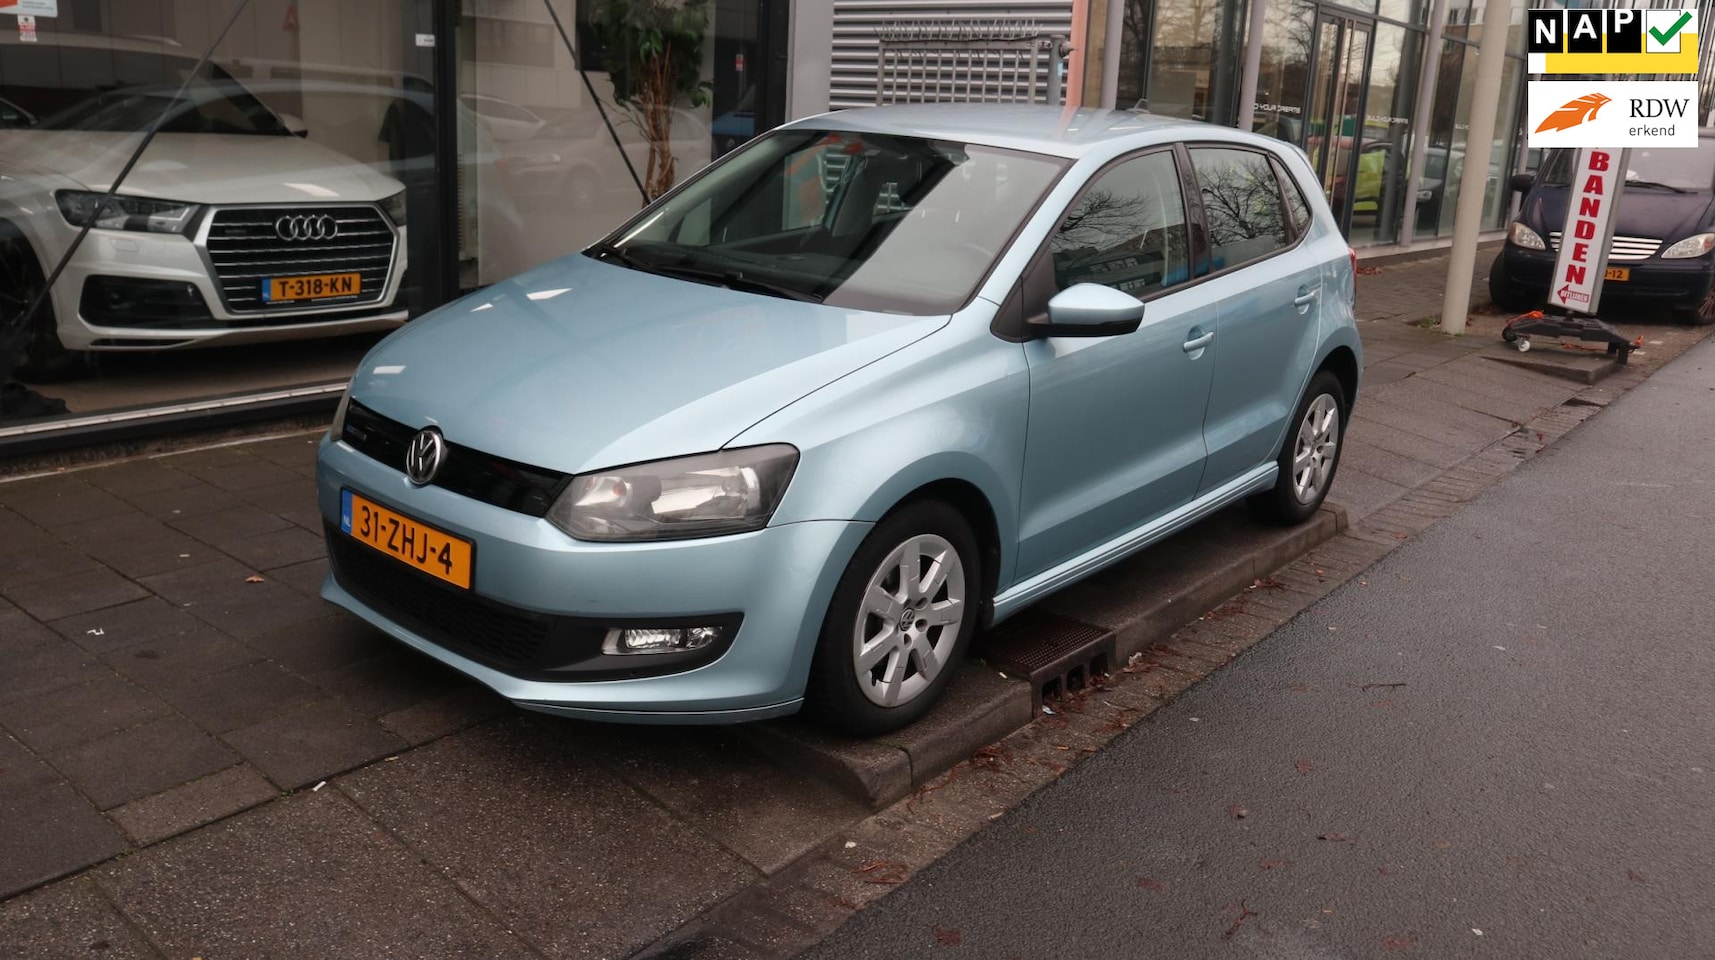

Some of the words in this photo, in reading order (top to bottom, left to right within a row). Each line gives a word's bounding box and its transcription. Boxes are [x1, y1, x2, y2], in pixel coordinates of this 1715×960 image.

[1565, 151, 1610, 285] BANDEN
[279, 276, 352, 297] T-318-KN
[360, 505, 452, 575] 31-ZHJ-4
